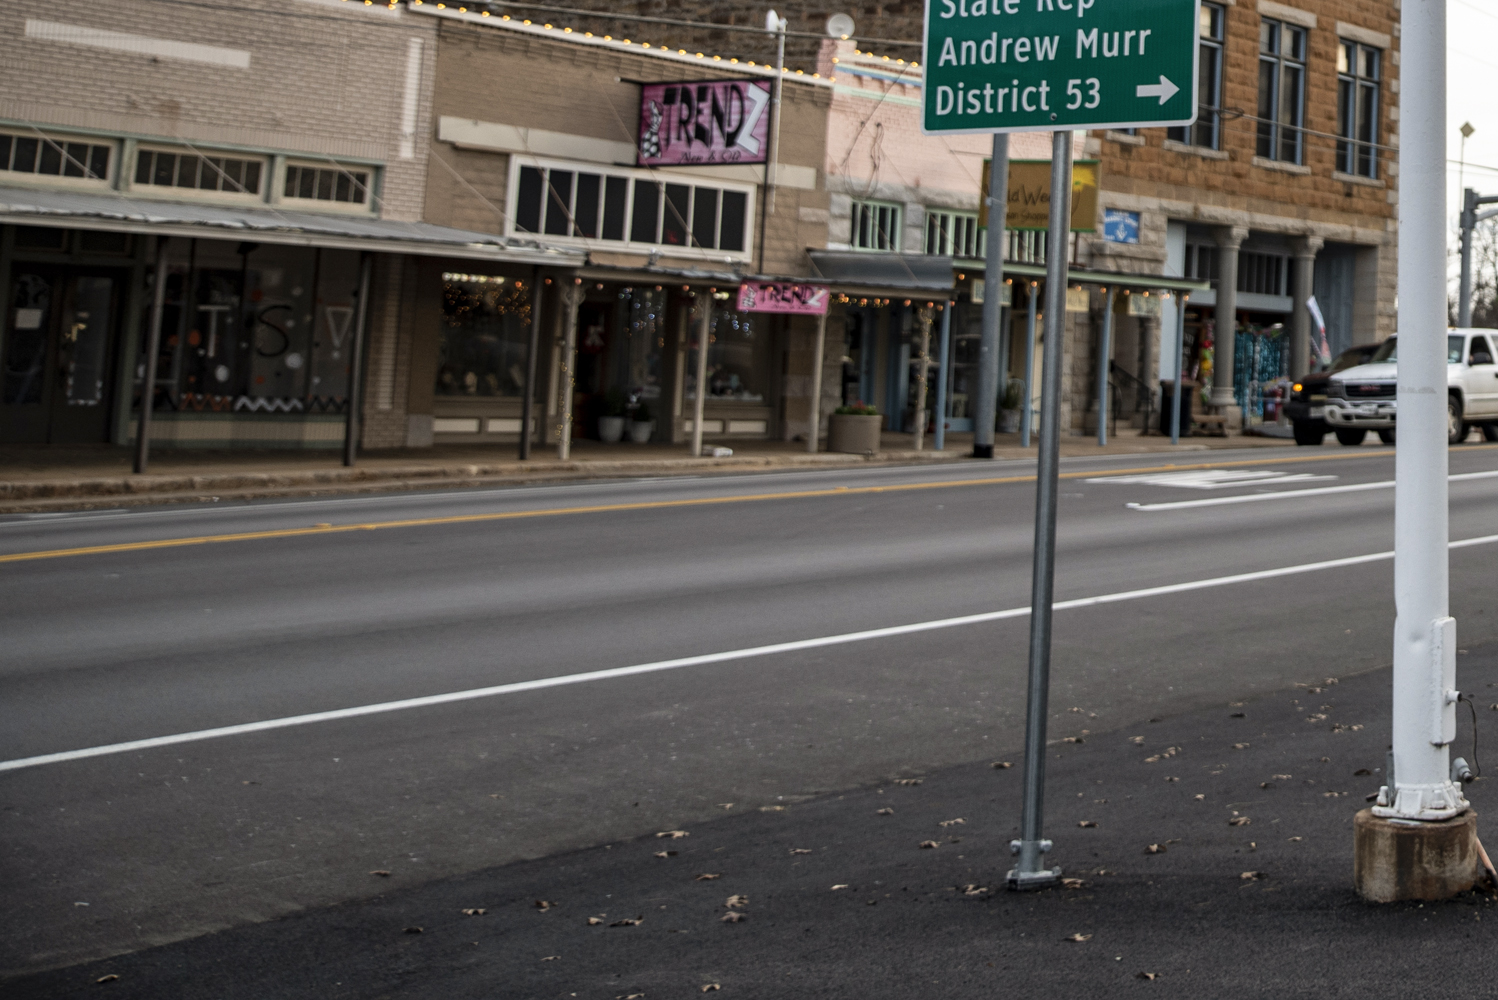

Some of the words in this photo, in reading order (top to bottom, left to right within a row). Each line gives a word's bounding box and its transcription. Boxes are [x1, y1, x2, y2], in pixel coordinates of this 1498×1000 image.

[937, 31, 1060, 67] Andrew
[1076, 27, 1152, 60] Murr
[935, 78, 1050, 116] District
[1065, 77, 1101, 110] 53
[663, 81, 771, 157] TRENDZ
